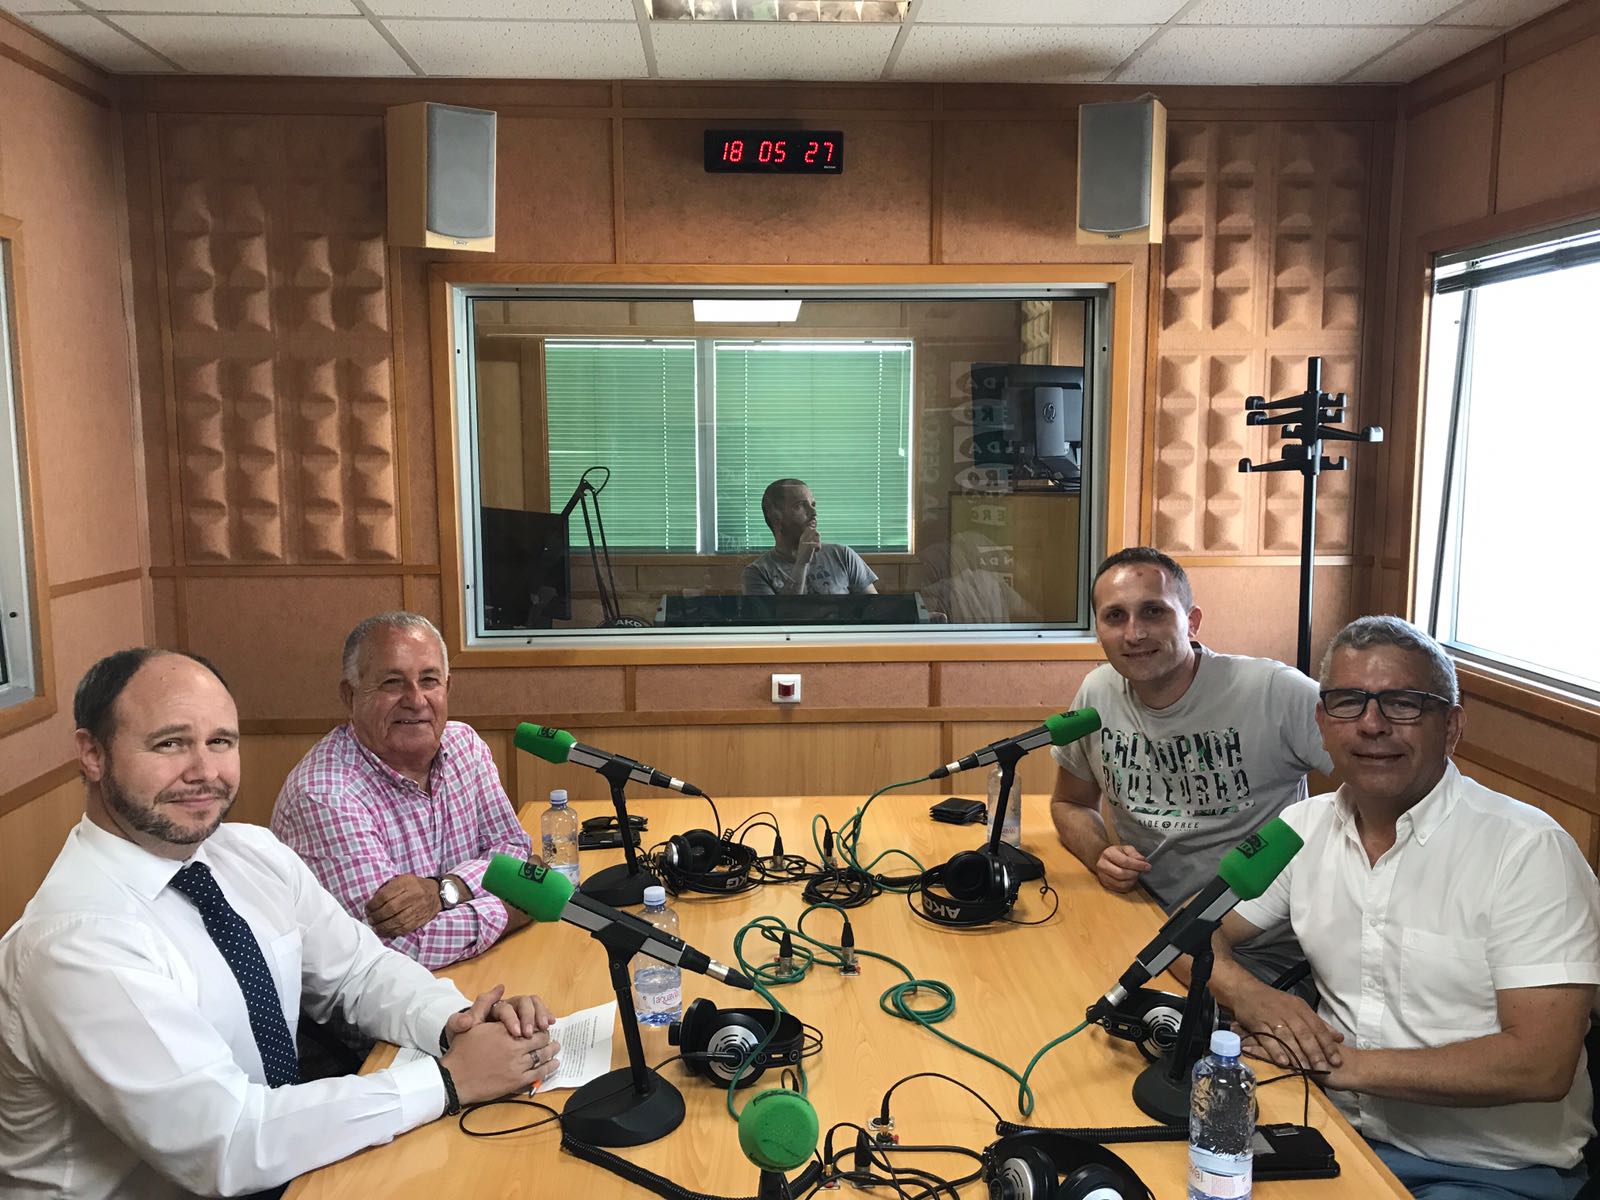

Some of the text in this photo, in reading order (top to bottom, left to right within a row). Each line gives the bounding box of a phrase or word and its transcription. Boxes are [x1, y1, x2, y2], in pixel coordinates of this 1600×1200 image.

[722, 140, 834, 163] 18 05 27
[1174, 821, 1200, 829] FREE
[725, 872, 748, 889] KG
